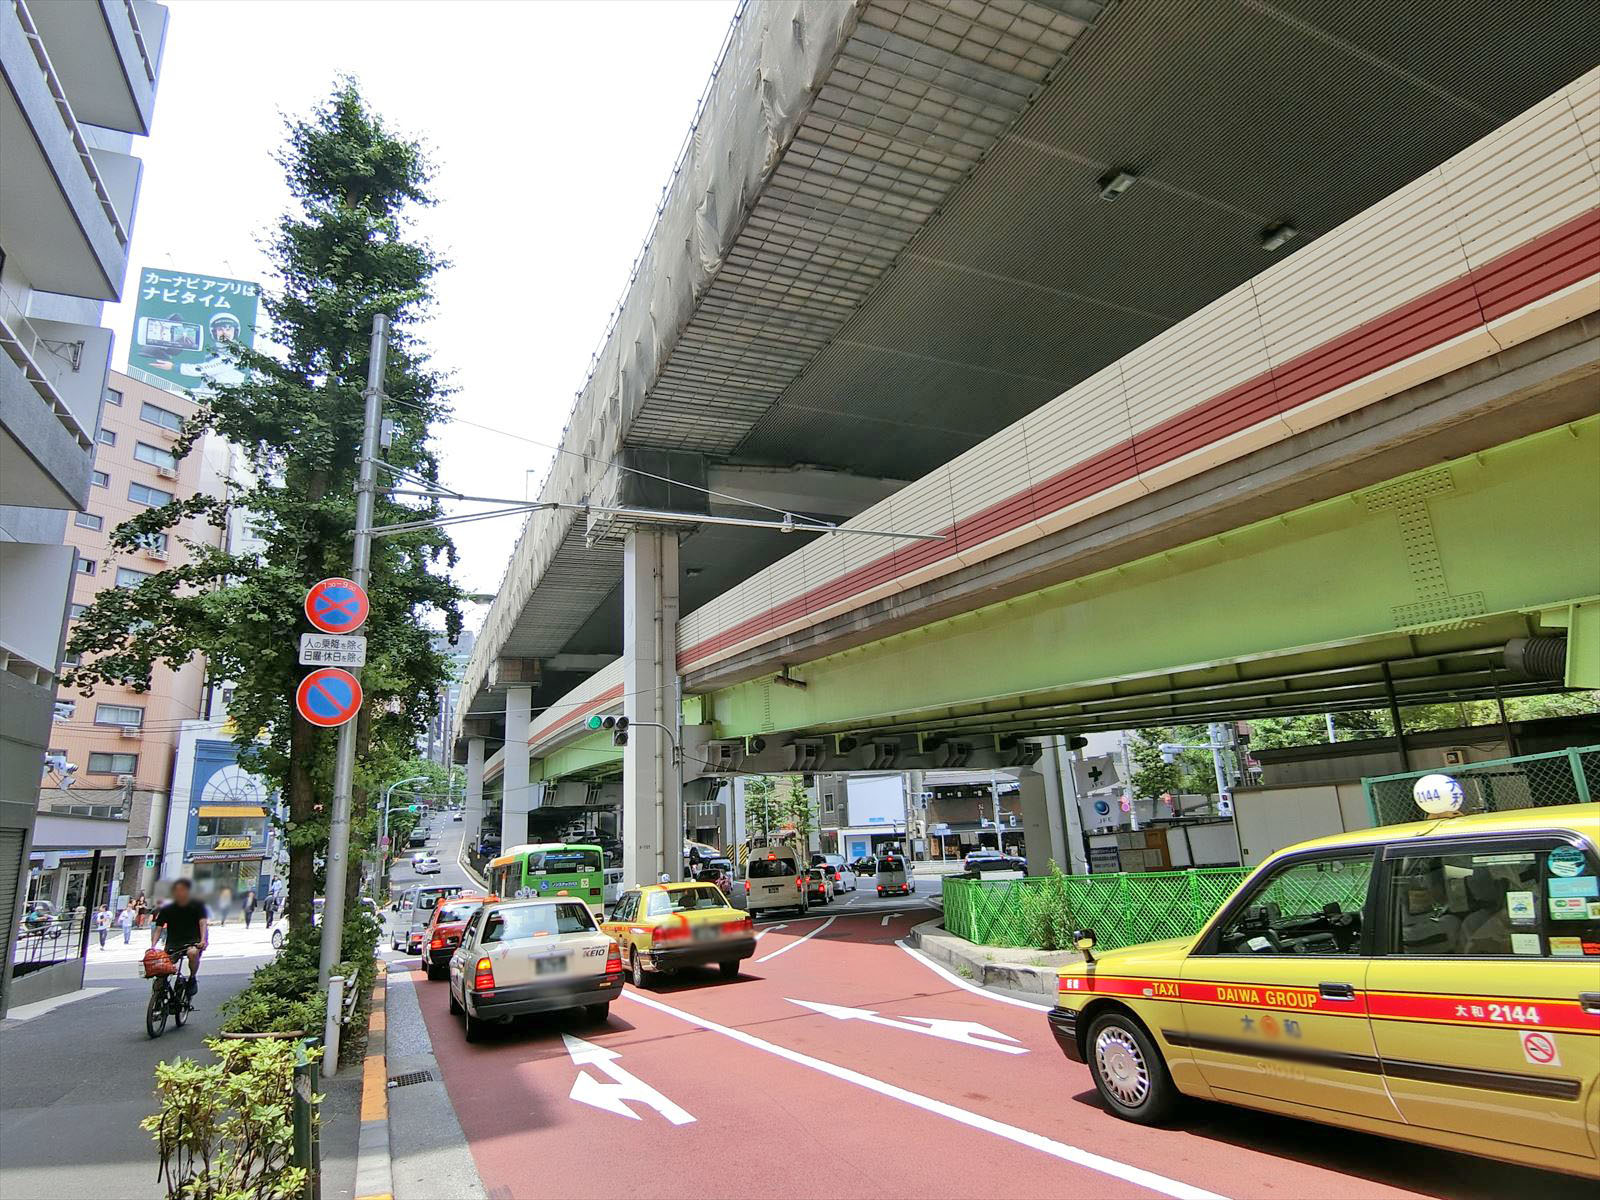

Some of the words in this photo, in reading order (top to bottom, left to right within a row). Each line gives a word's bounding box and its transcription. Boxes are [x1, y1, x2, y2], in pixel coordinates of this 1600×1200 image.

[145, 272, 256, 297] カーナビアプリは
[143, 287, 231, 309] ナビタイム
[304, 638, 363, 650] 人の乗降を除く
[583, 949, 605, 958] KEIO
[1152, 983, 1180, 997] TAXI
[1216, 987, 1260, 1003] DAIWA
[1265, 991, 1317, 1008] GROUP
[1488, 1003, 1540, 1023] 2144
